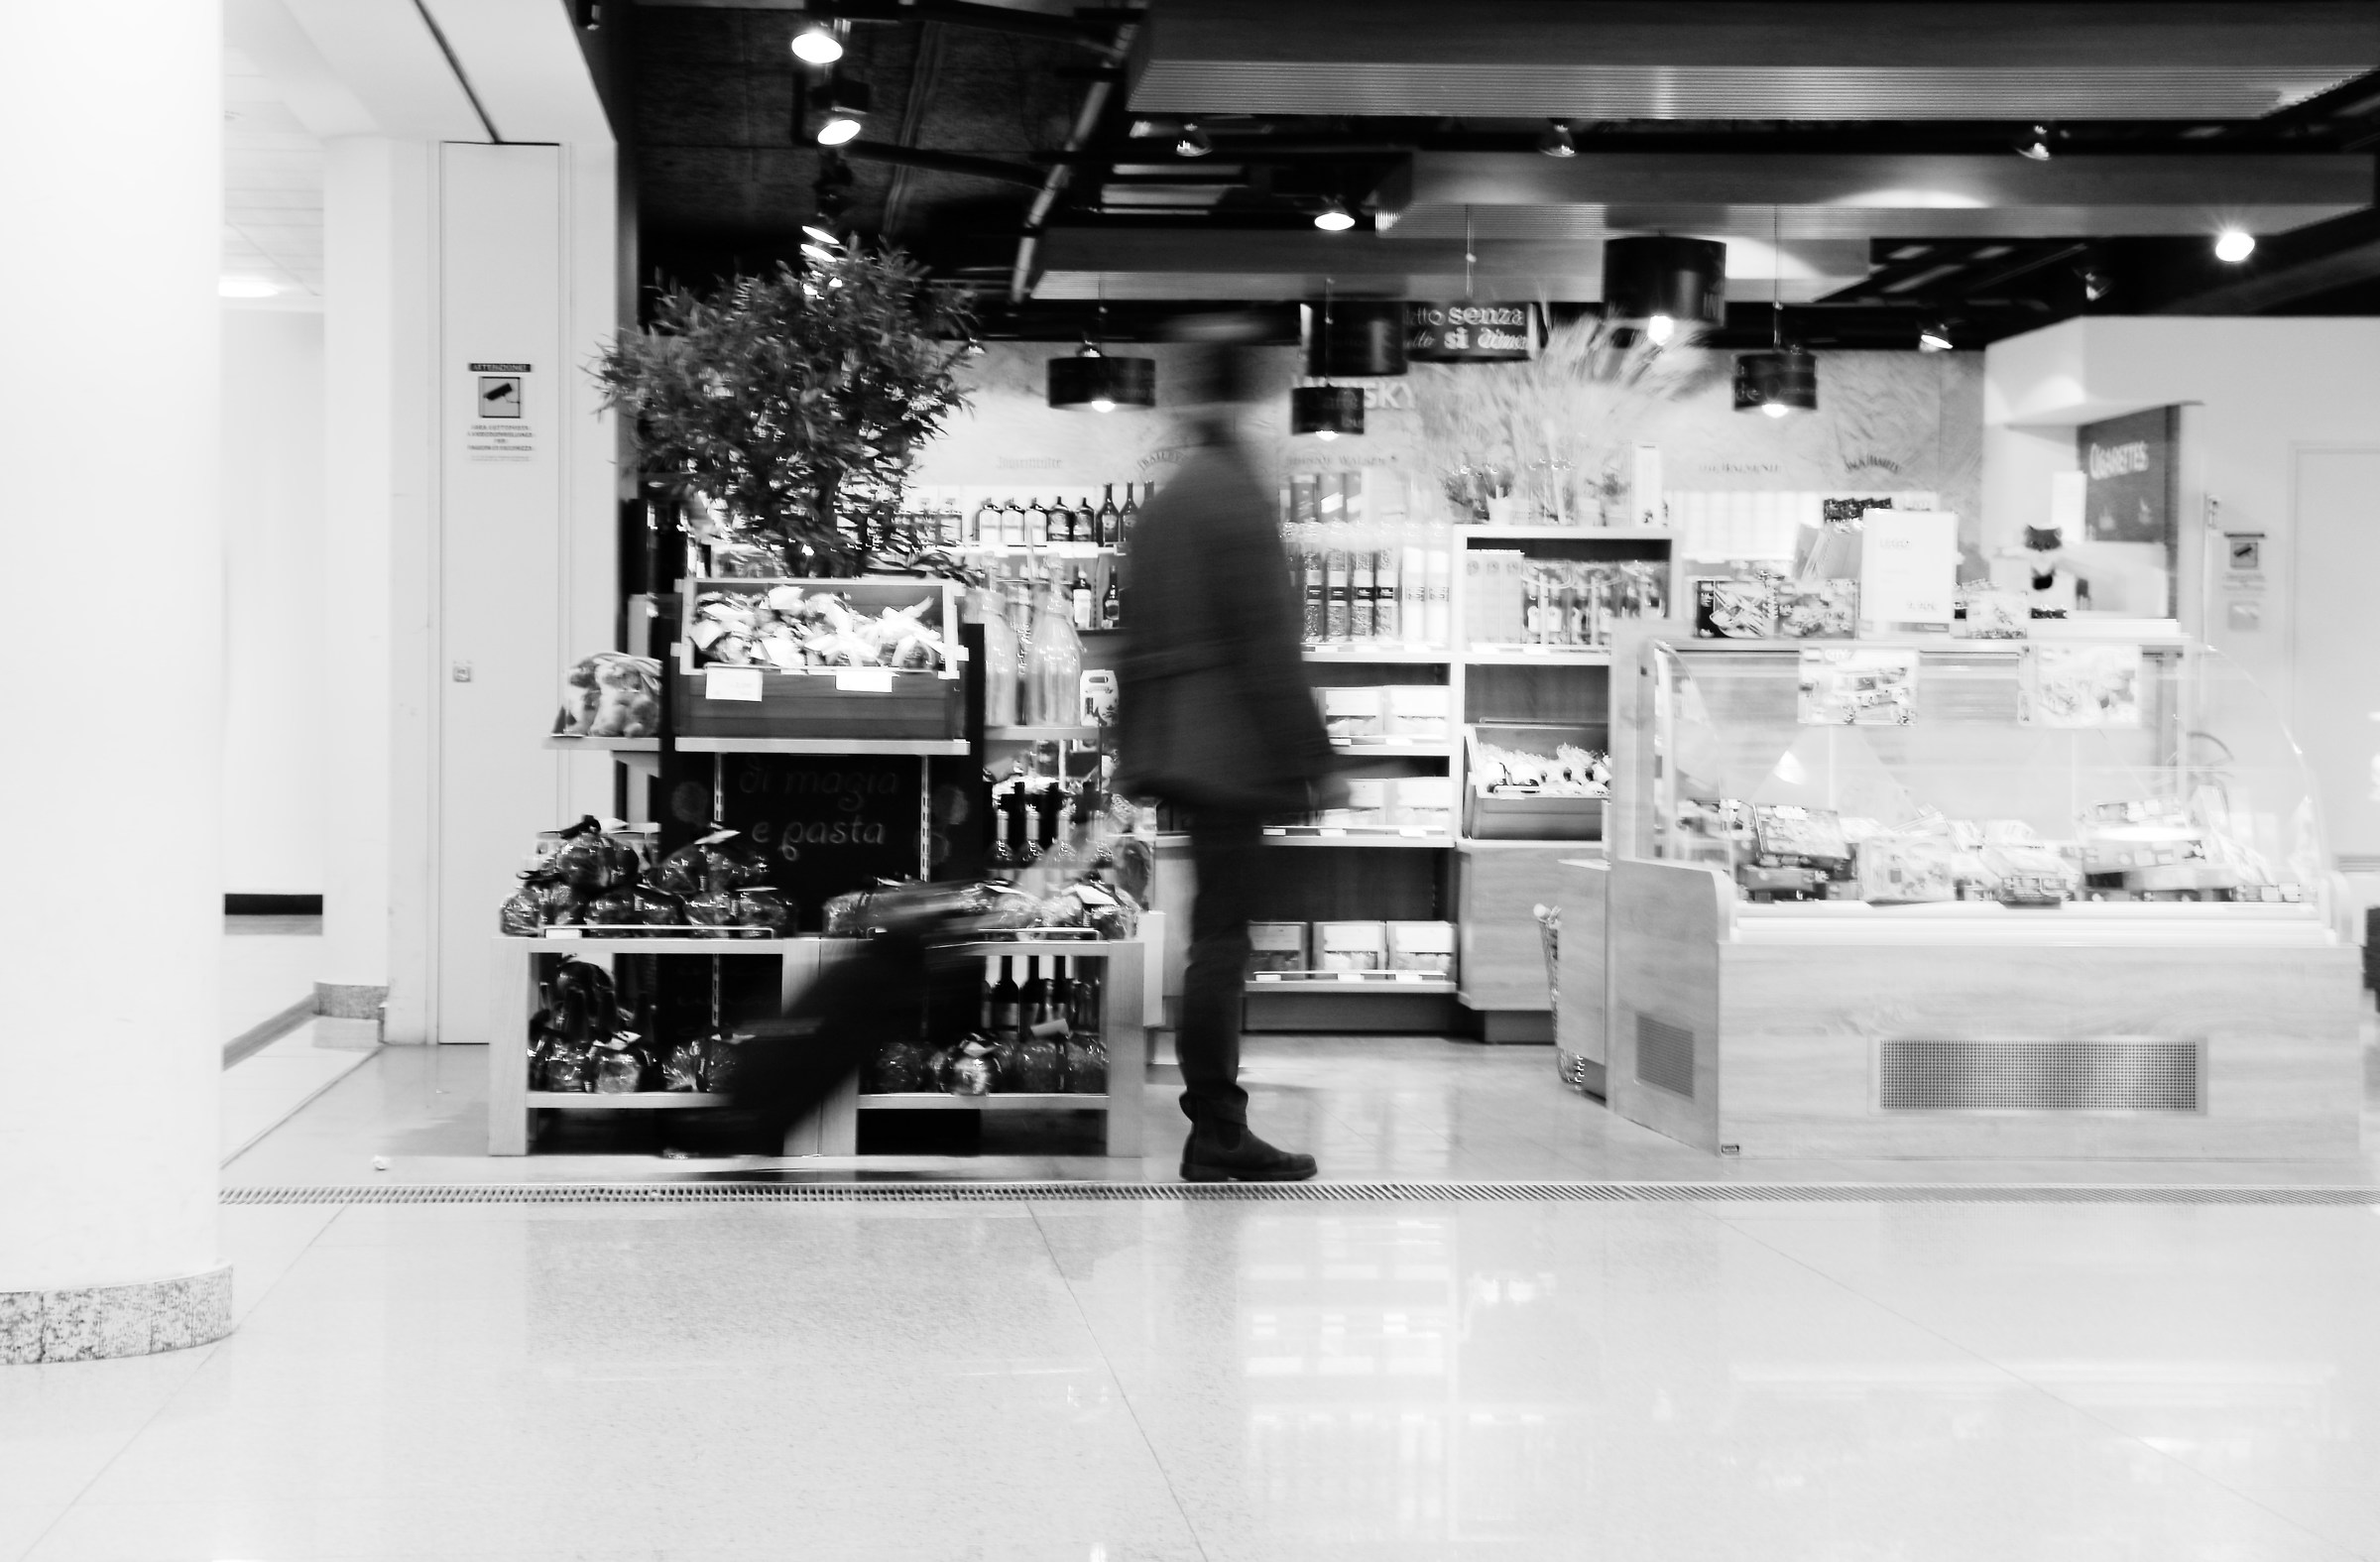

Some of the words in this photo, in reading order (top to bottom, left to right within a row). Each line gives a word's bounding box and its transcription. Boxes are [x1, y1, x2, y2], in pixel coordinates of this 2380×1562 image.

[2089, 440, 2149, 480] CIGARETTES
[739, 754, 771, 794] di
[785, 766, 900, 811] magia
[751, 819, 771, 844] e
[777, 813, 888, 862] pasta
